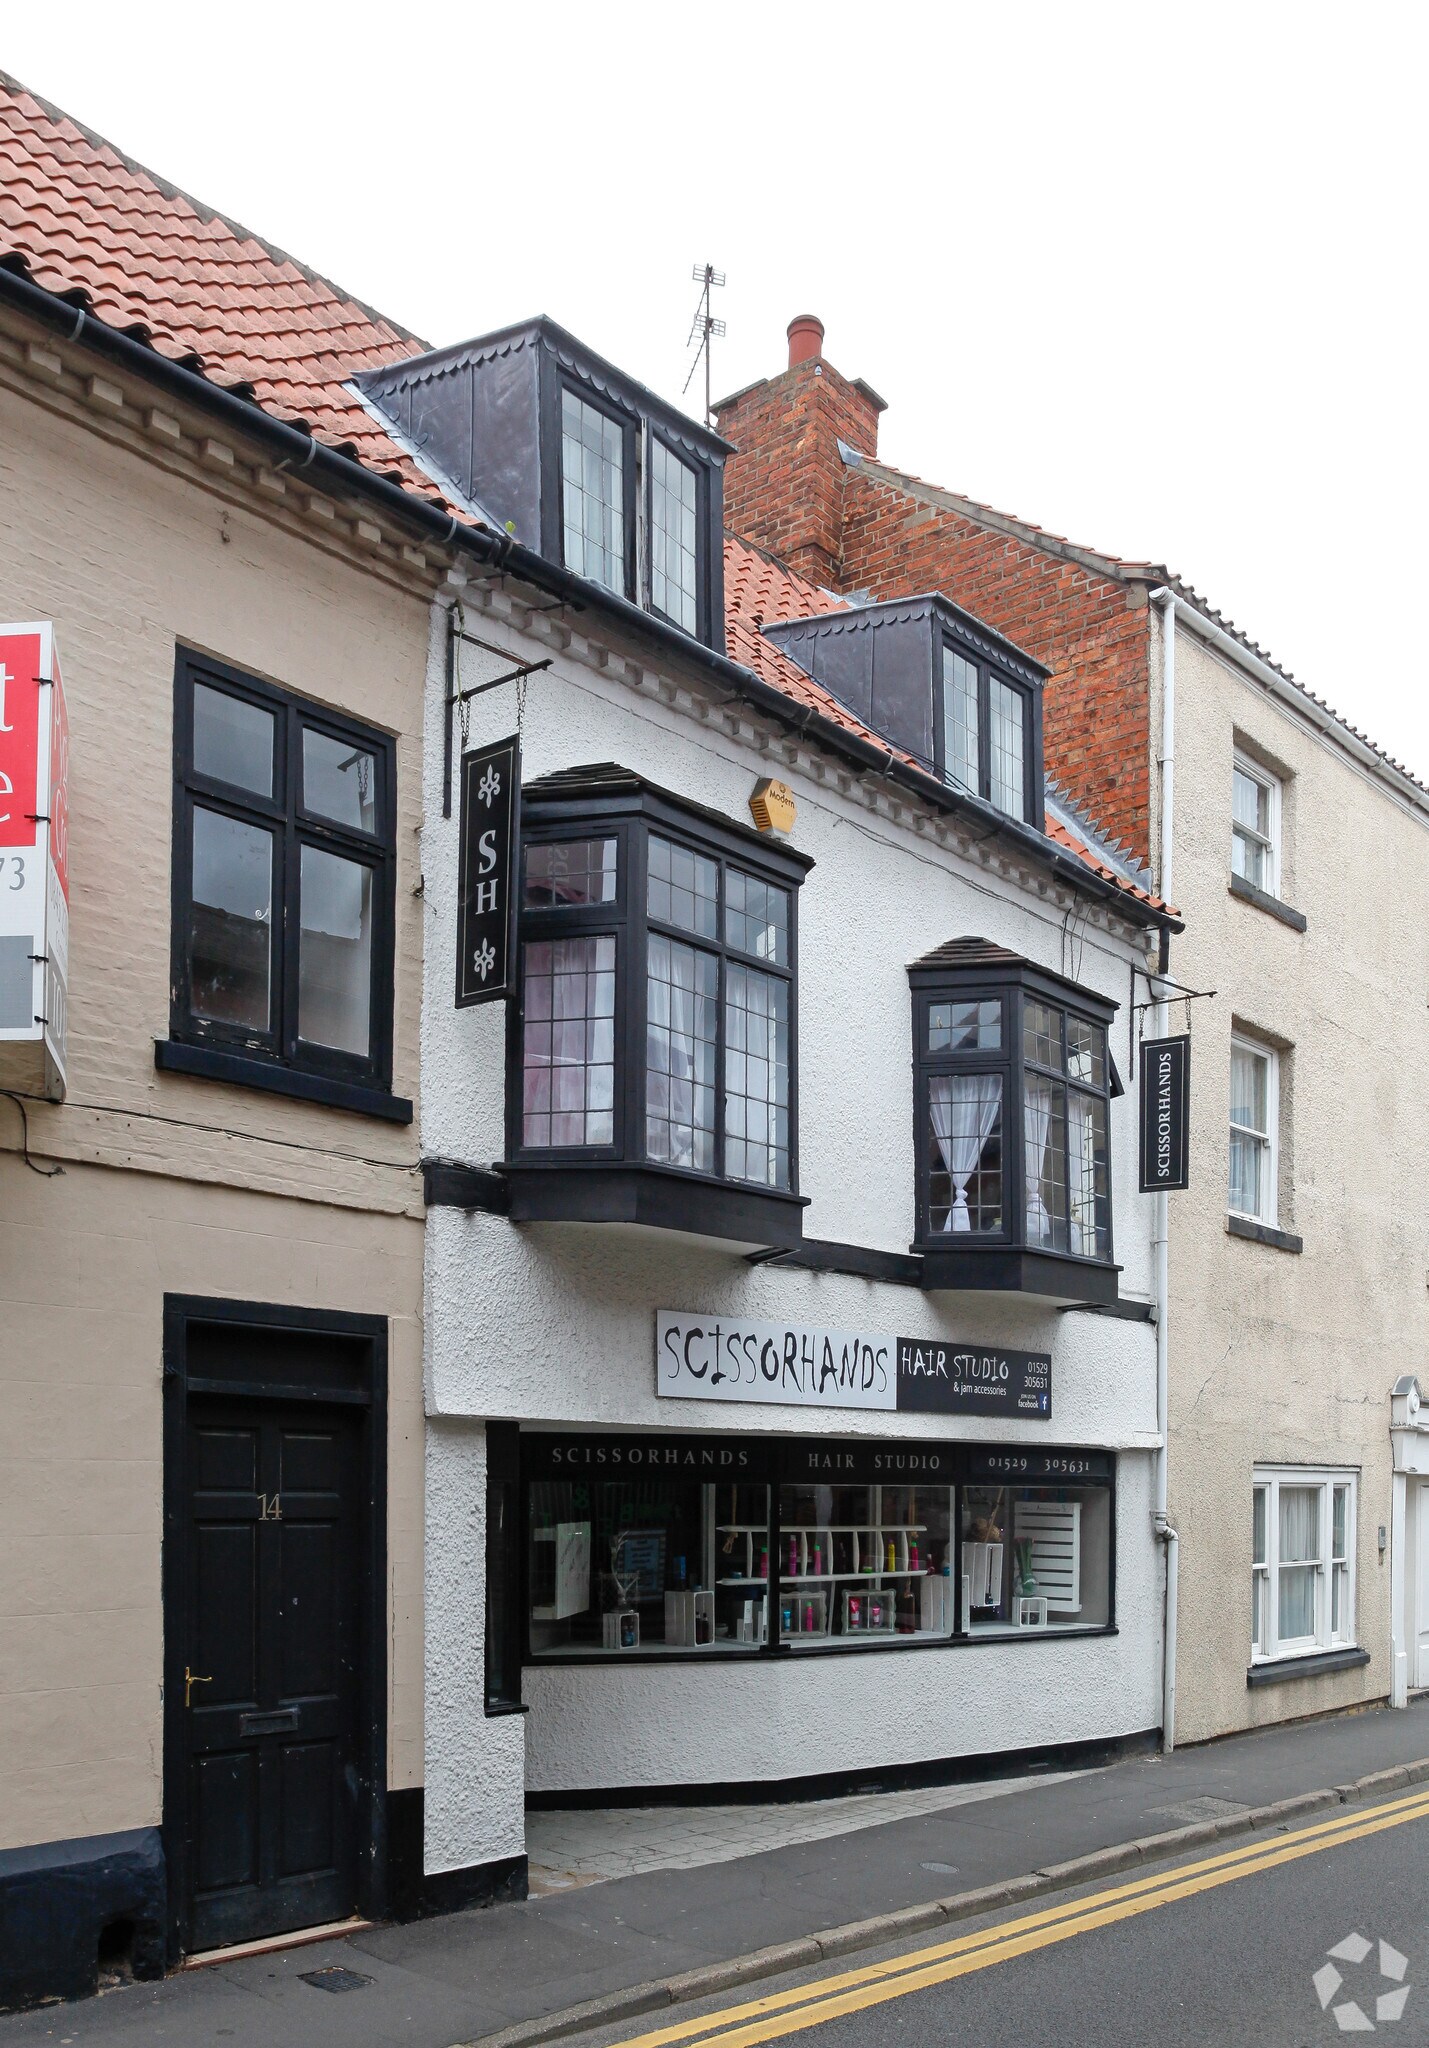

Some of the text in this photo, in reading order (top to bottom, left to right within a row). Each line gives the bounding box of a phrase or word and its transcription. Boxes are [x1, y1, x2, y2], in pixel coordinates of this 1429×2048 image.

[769, 790, 795, 809] Modern
[1158, 1053, 1172, 1177] SCISSORHANDS
[664, 1323, 888, 1394] SCISSORHANDS
[901, 1347, 1009, 1382] HAIR STUDIO
[1027, 1361, 1048, 1374] 01529
[953, 1381, 1007, 1396] & jam accessories
[1024, 1376, 1048, 1388] 305631
[1018, 1398, 1039, 1408] facebook
[552, 1448, 1090, 1473] SCISSORHANDS HAIR STUDIO 01529 305631
[257, 1493, 282, 1520] 14
